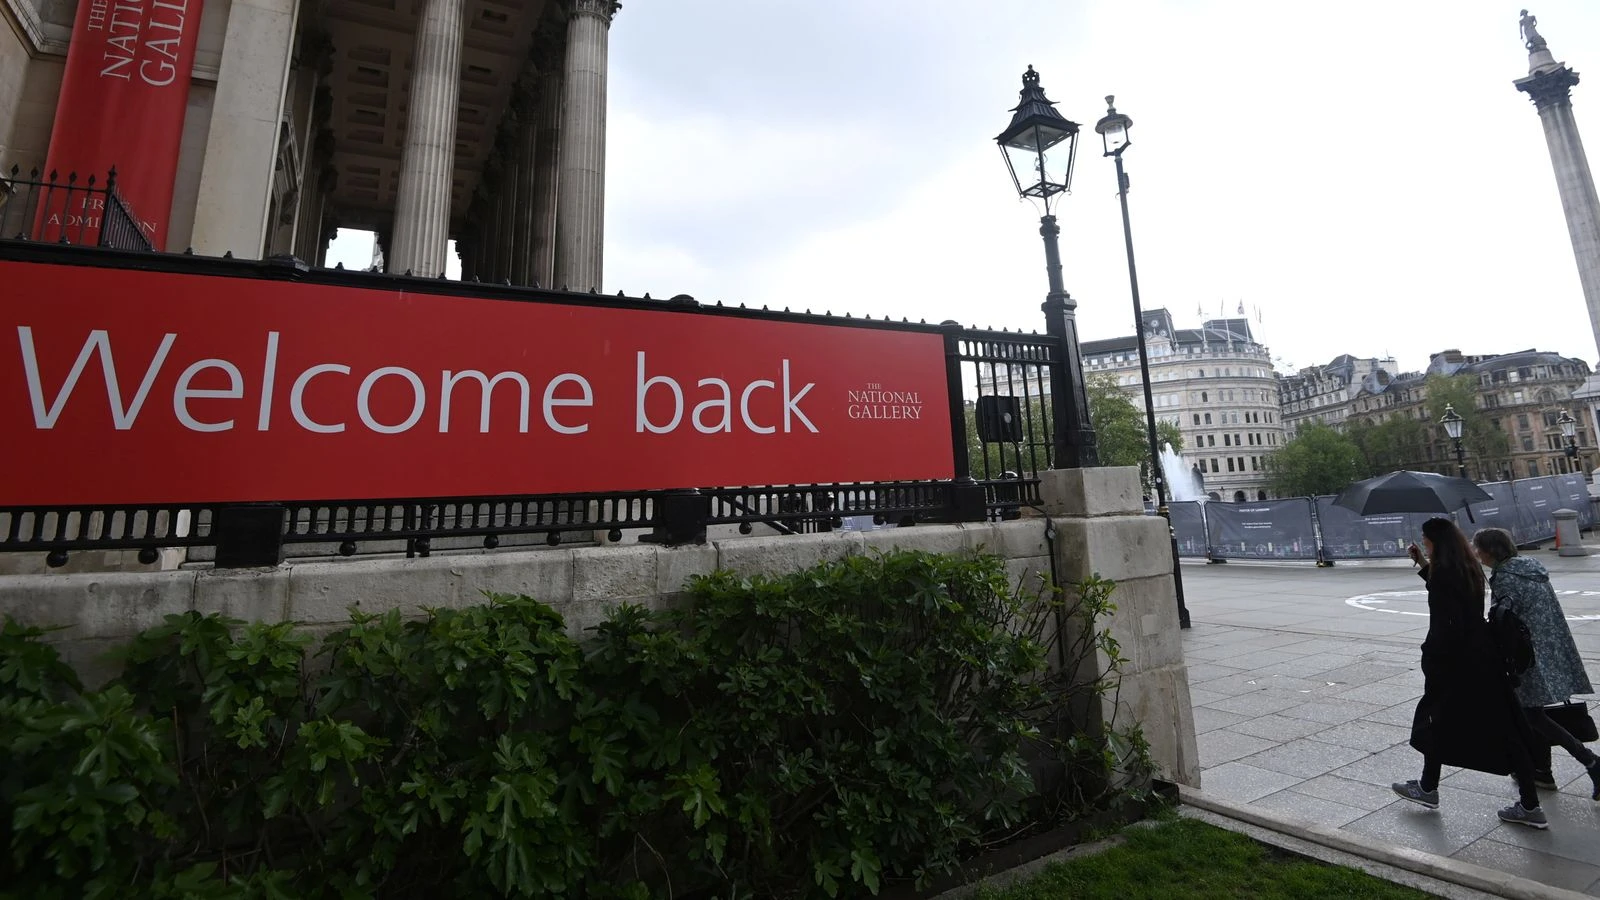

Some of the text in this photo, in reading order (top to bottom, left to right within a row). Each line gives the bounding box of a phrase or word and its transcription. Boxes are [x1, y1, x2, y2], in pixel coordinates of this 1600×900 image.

[100, 0, 144, 82] NATI
[17, 326, 820, 434] Welcome back
[867, 382, 881, 390] THE
[848, 390, 922, 404] NATIONAL
[848, 404, 922, 420] GALLERY
